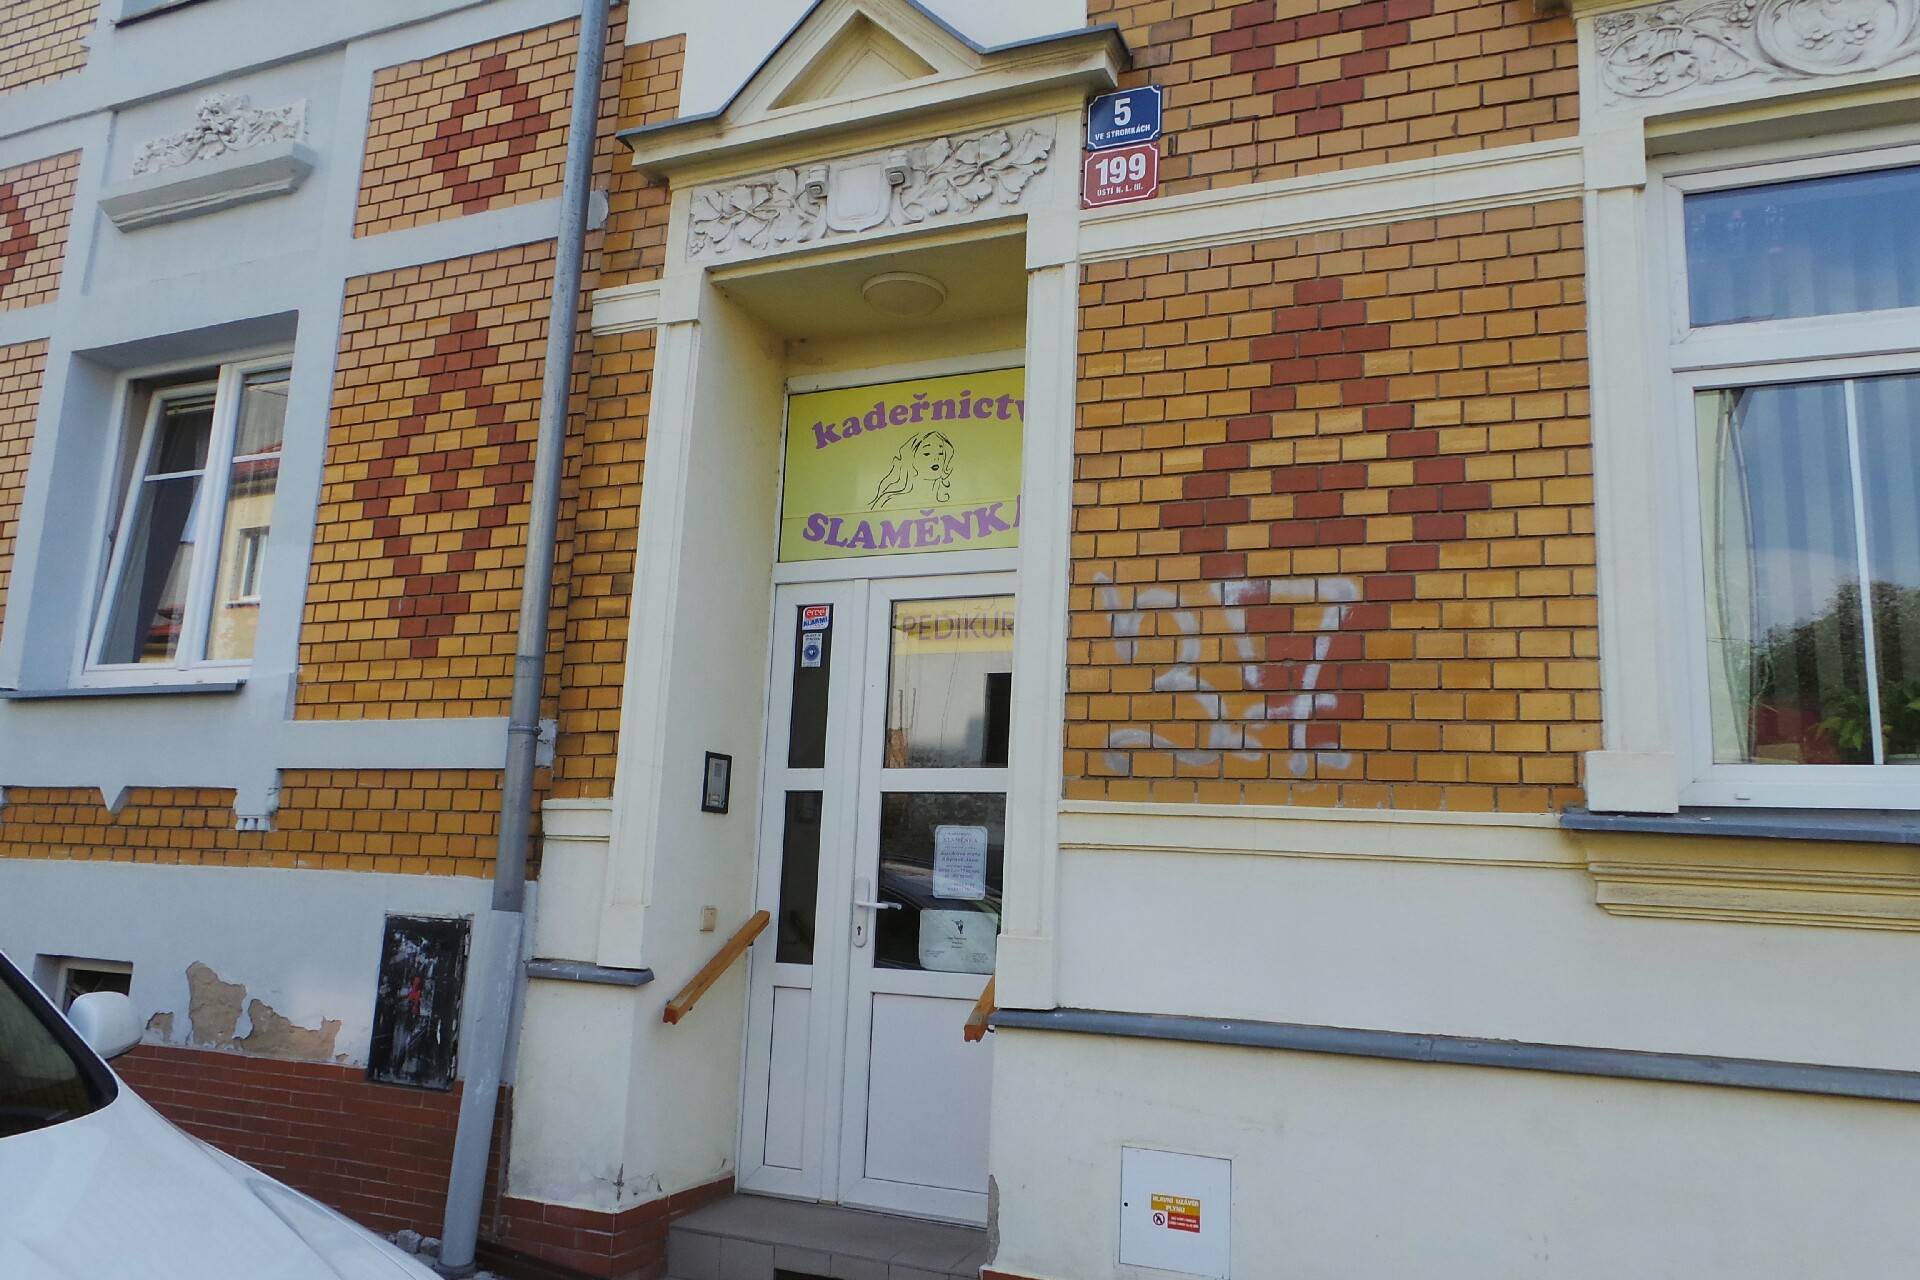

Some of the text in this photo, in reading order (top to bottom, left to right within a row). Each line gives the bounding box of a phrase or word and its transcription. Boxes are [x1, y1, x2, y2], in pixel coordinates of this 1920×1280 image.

[1114, 97, 1132, 126] 5
[1106, 124, 1151, 139] STROMKÁCH
[1095, 153, 1146, 186] 199
[803, 494, 1021, 549] SLAMĚNK
